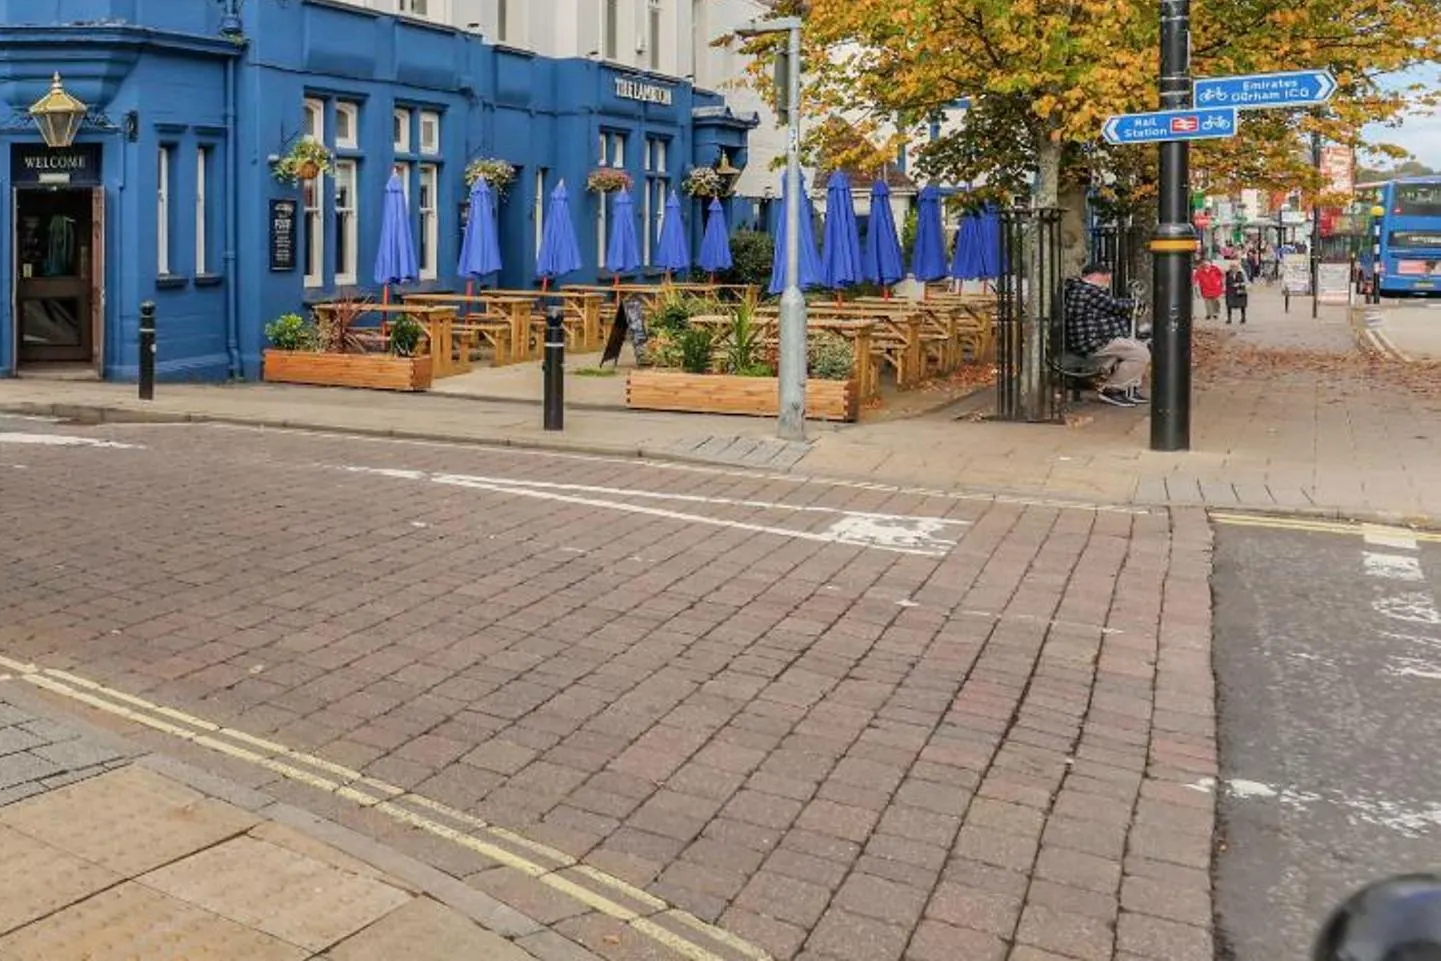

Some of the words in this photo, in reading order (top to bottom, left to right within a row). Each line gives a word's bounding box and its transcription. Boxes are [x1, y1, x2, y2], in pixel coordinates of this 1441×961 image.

[1242, 79, 1297, 91] Emirates
[1231, 91, 1280, 102] Durham
[1135, 117, 1157, 127] Rail
[1124, 127, 1167, 139] Station
[24, 155, 87, 169] WELCOME
